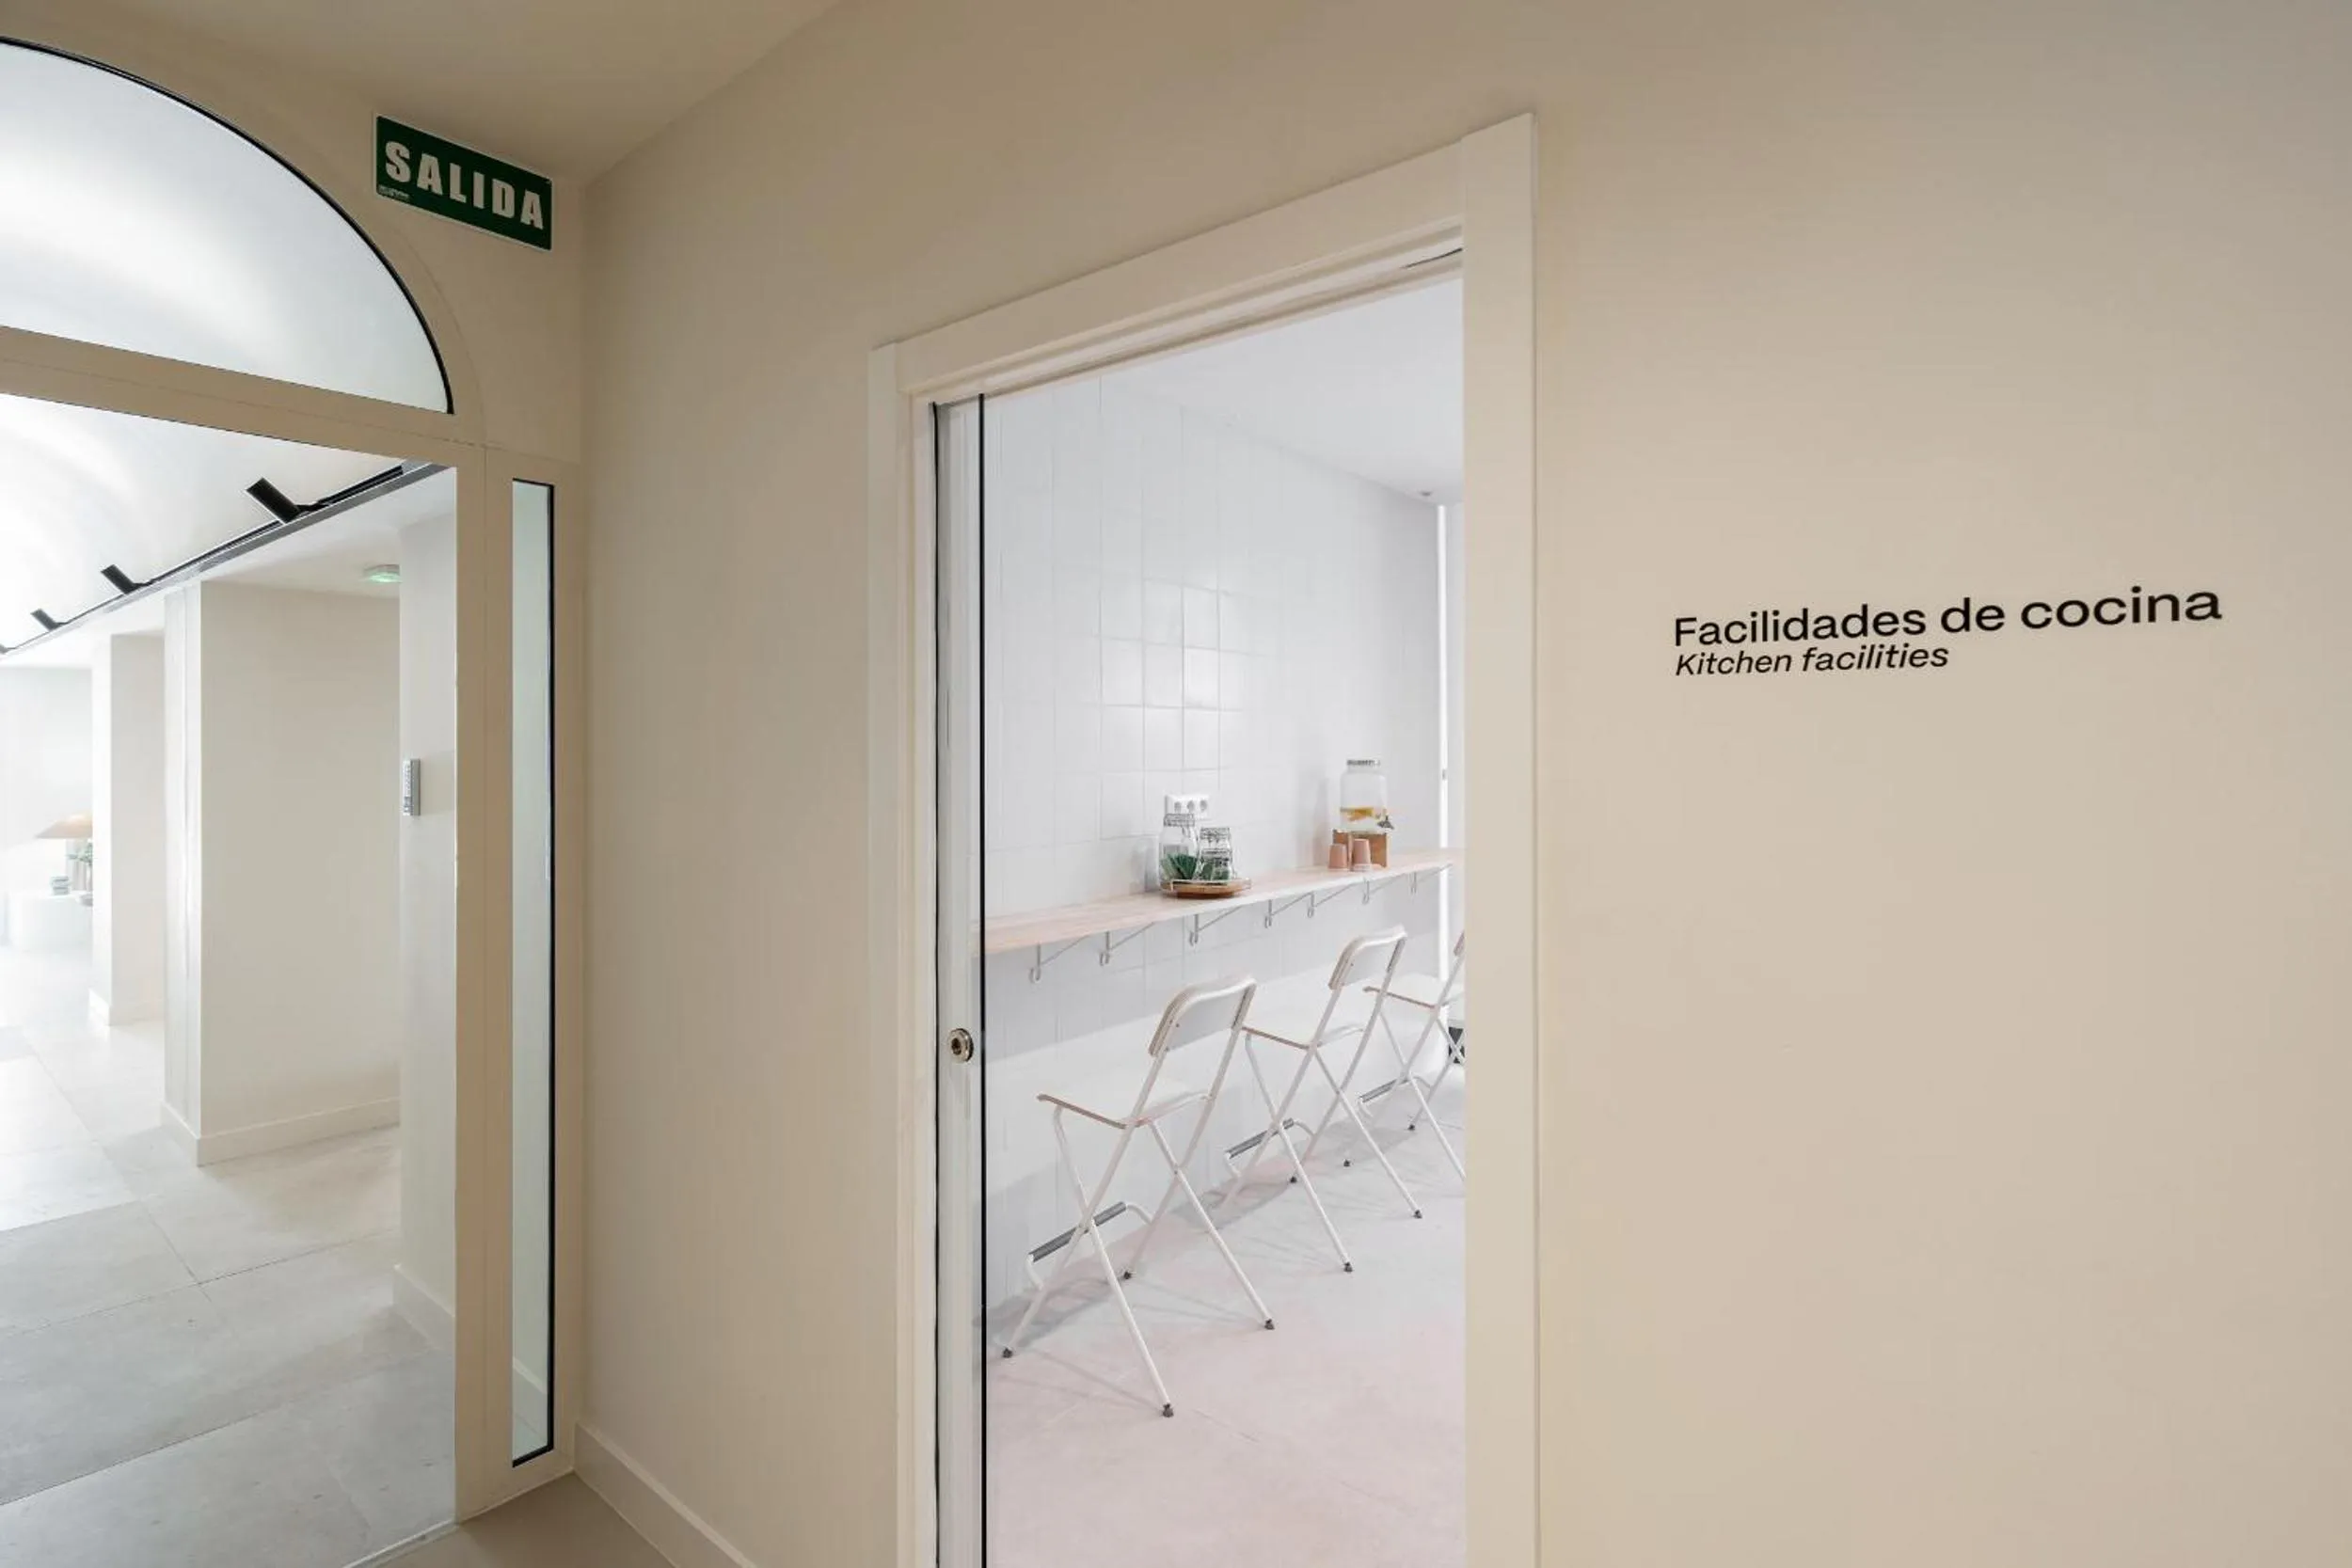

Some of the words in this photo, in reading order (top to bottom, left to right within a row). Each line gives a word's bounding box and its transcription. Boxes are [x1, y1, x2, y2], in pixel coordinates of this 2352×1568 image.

[384, 140, 545, 230] SALIDA
[1675, 603, 1927, 647] Facilidades
[1940, 596, 2006, 634] de
[2020, 585, 2223, 629] cocina
[1675, 651, 1792, 675] Kitchen
[1802, 642, 1949, 672] facilities
